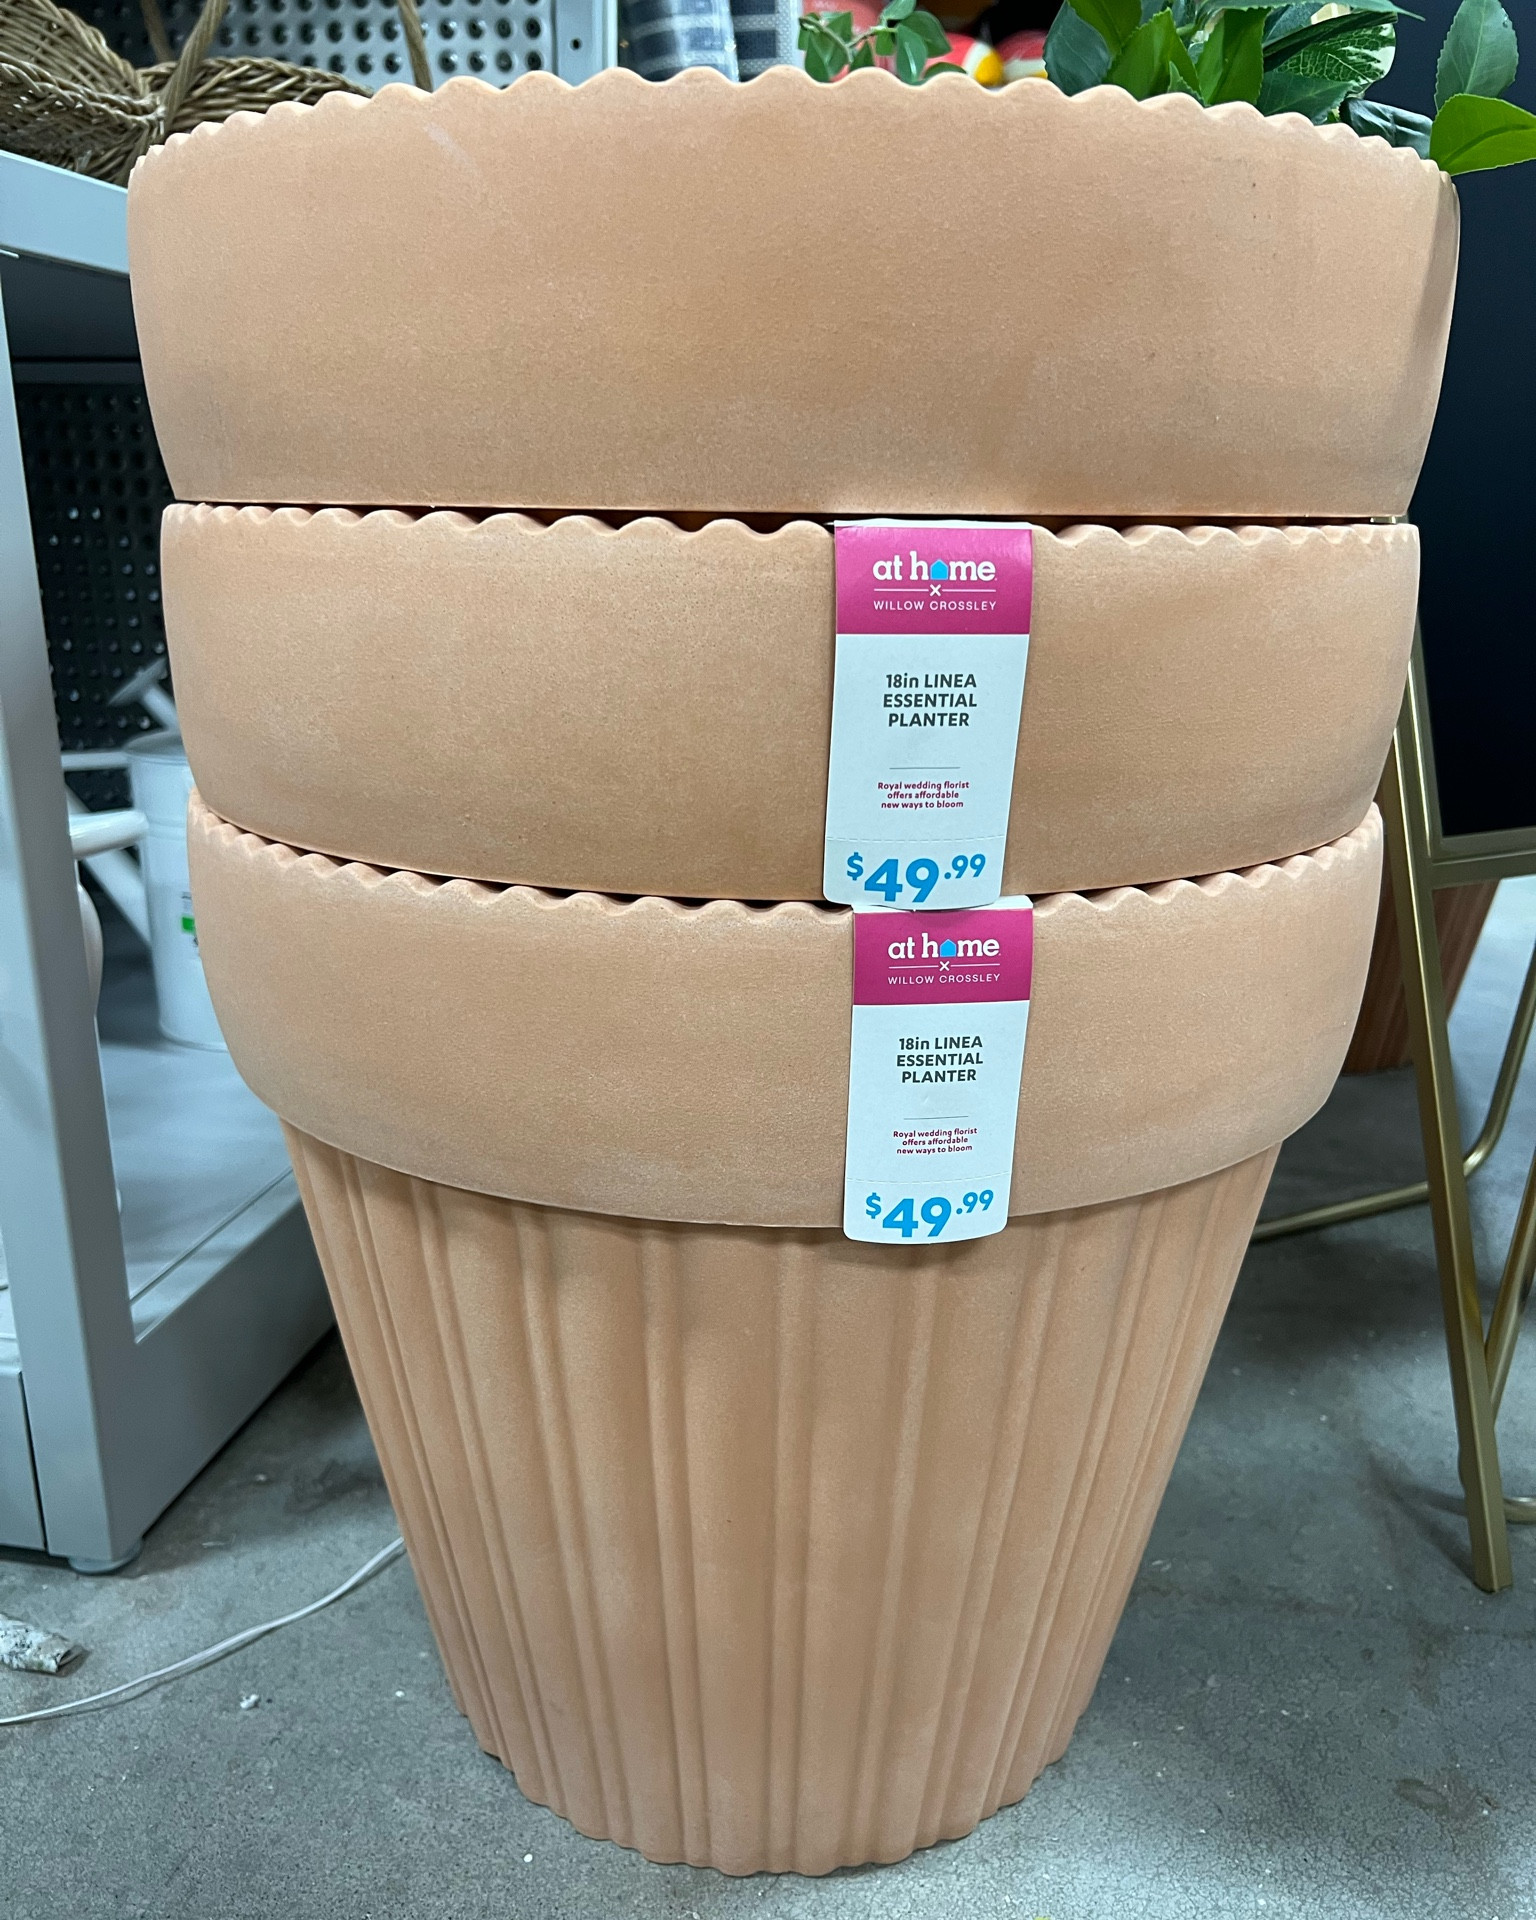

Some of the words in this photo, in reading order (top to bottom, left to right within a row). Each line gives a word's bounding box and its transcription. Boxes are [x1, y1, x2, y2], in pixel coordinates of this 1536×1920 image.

[873, 552, 902, 581] at
[873, 601, 925, 611] WILLOW
[929, 601, 996, 611] CROSSLEY
[886, 673, 919, 688] 18in
[924, 674, 977, 688] LINEA
[883, 694, 978, 708] ESSENTIAL
[888, 713, 970, 727] PLANTER
[878, 781, 902, 791] Royal
[904, 781, 942, 791] wedding
[944, 781, 970, 789] florist
[887, 791, 913, 799] offers
[914, 791, 959, 799] affordable
[881, 801, 900, 809] new
[901, 801, 923, 810] ways
[937, 800, 964, 808] bloom
[888, 937, 915, 959] at
[888, 975, 935, 985] WILLOW
[940, 974, 1000, 984] CROSSLEY
[899, 1037, 930, 1050] 18in
[934, 1036, 983, 1049] LINEA
[897, 1053, 984, 1067] ESSENTIAL
[902, 1070, 977, 1083] PLANTER
[893, 1130, 916, 1140] Royal
[918, 1129, 953, 1139] wedding
[954, 1127, 978, 1135] florist
[902, 1138, 926, 1146] offers
[927, 1136, 969, 1145] affordable
[948, 1144, 973, 1153] bloom
